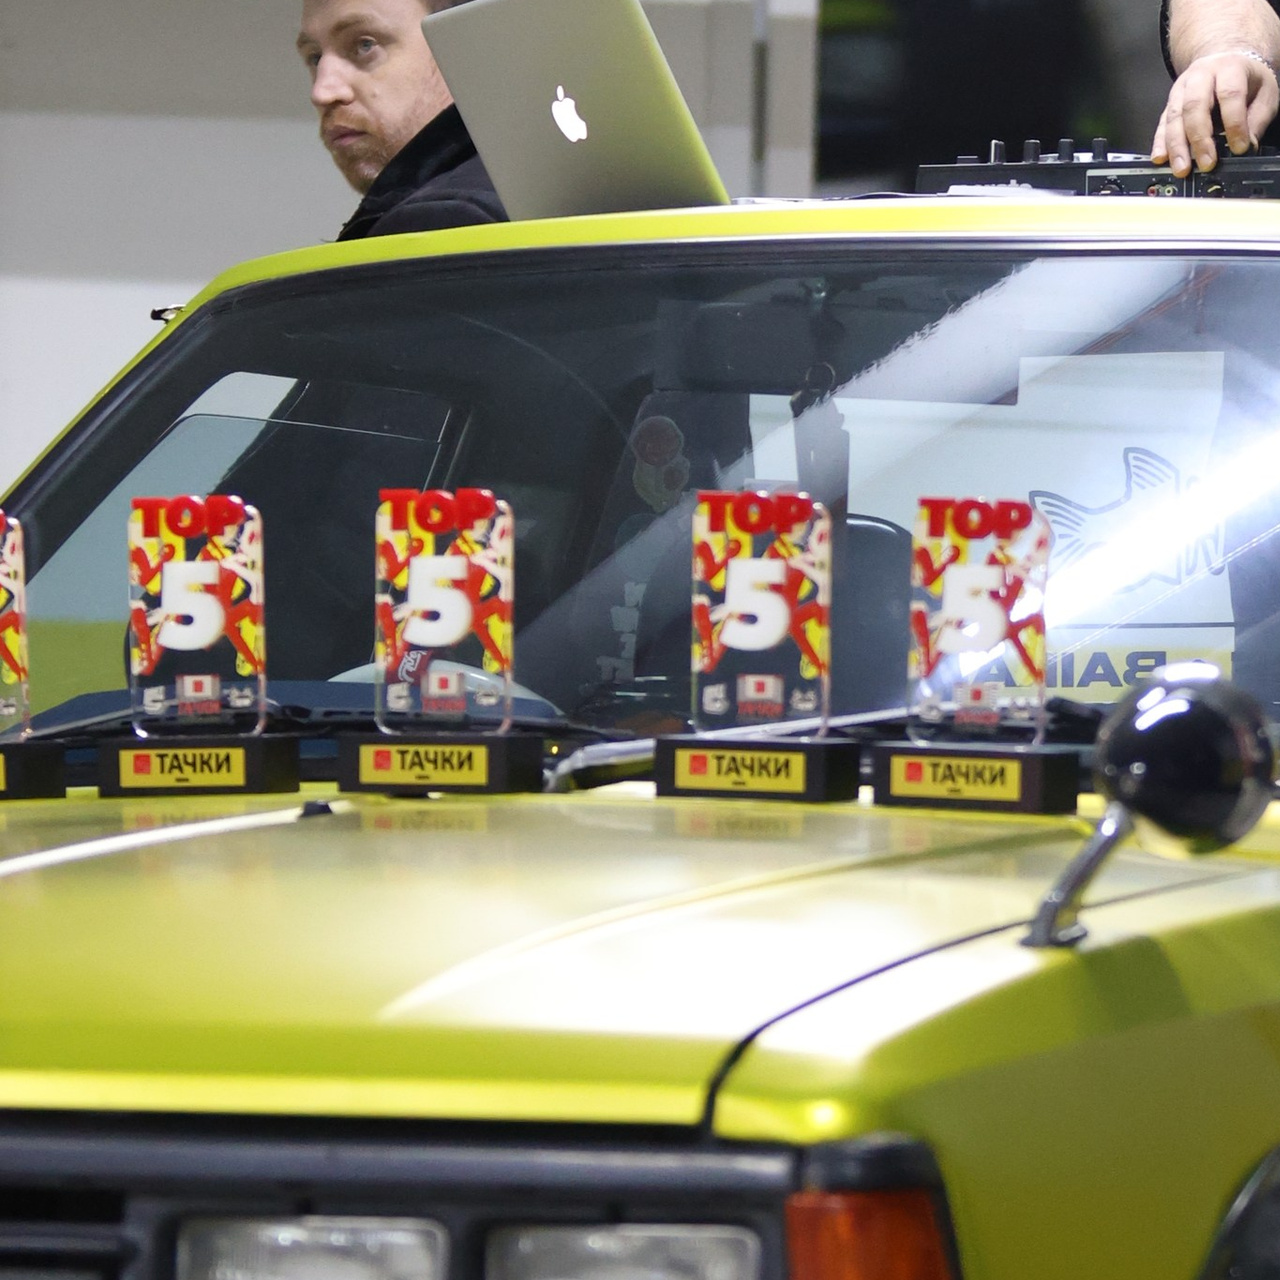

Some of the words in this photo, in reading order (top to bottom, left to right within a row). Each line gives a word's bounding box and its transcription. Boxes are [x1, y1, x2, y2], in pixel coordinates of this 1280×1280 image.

[131, 495, 245, 538] TOP
[378, 488, 496, 534] TOP
[697, 490, 813, 534] TOP
[919, 497, 1033, 539] TOP
[157, 560, 226, 651] 5
[402, 555, 473, 647] 5
[719, 558, 790, 651] 5
[936, 564, 1008, 653] 5
[156, 752, 231, 774] ТАЧКИ
[396, 750, 473, 771] ТАЧКИ
[713, 754, 791, 778] ТАЧКИ
[929, 762, 1005, 785] ТАЧКИ
